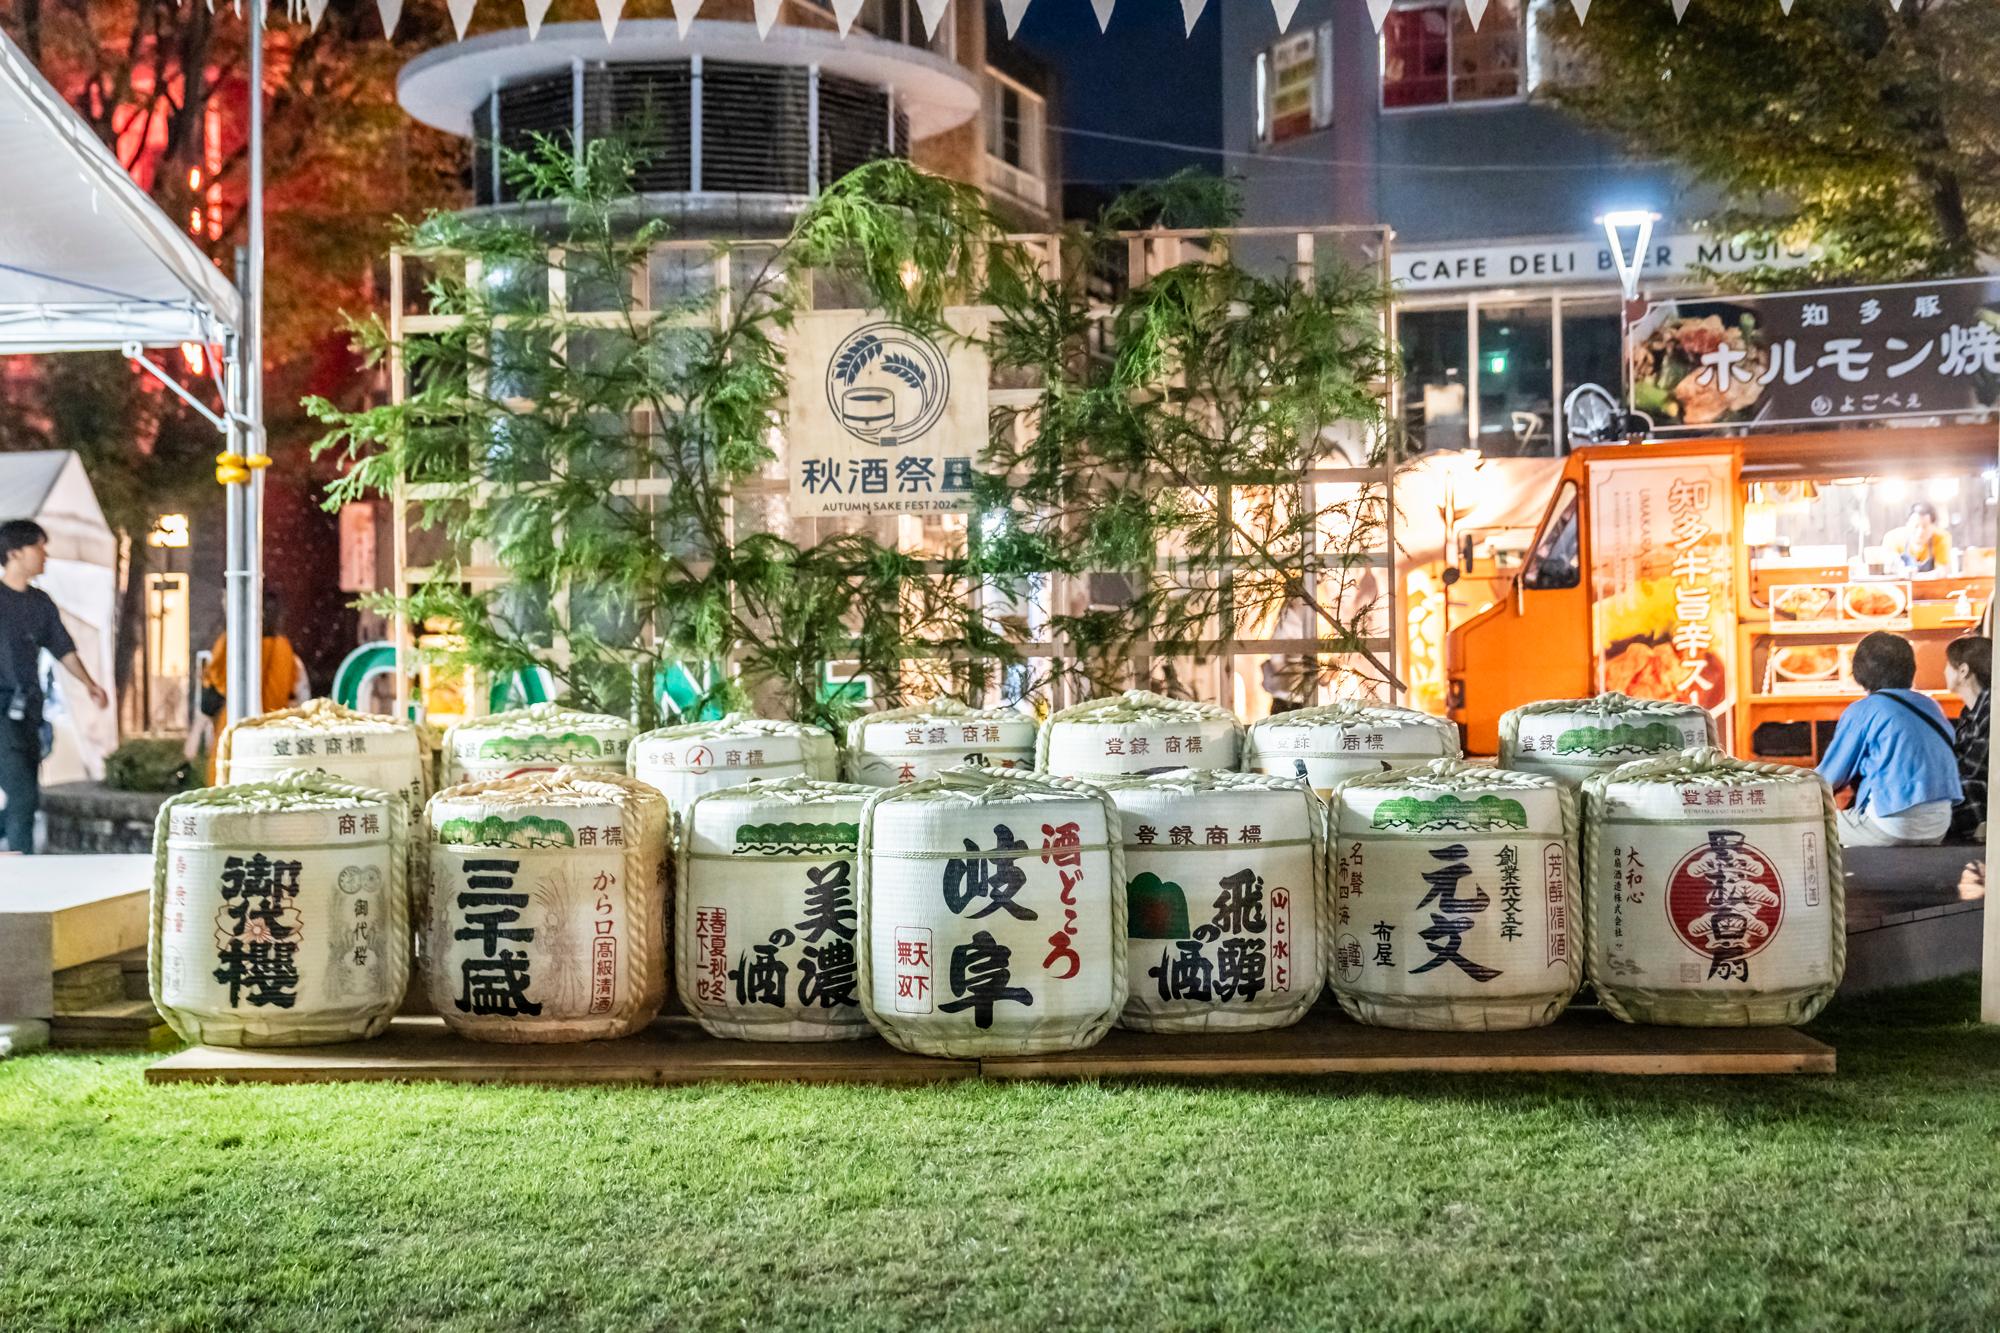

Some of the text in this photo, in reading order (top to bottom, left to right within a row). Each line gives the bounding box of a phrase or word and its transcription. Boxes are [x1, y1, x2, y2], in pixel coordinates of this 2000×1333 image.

[1409, 255, 1487, 281] CAFE
[1510, 251, 1575, 276] DELI
[1801, 294, 1942, 328] 知多豚
[1696, 322, 2000, 393] ホルモン焼
[801, 456, 936, 495] 秋酒祭
[822, 500, 958, 512] AUTUMN SAKE FEST 2024
[904, 725, 1000, 745] 登録商標
[1105, 735, 1203, 755] 登録商標
[1342, 733, 1384, 750] 商標
[1682, 789, 1767, 807] 登録商標
[338, 813, 380, 836] 商標
[577, 825, 625, 847] 商標
[1134, 824, 1263, 845] 登録商標
[1494, 843, 1523, 943] 創業元文五年
[1625, 846, 1645, 904] 大和心
[592, 869, 617, 936] から口
[1041, 821, 1084, 980] 酒どころ
[1408, 843, 1504, 983] 元文
[352, 899, 370, 967] 御代桜
[454, 859, 544, 1017] 三千盛
[938, 823, 1039, 1030] 岐阜
[1272, 892, 1289, 985] 山と水と
[1370, 920, 1396, 968] 布屋
[708, 908, 727, 1002] 春夏秋冬
